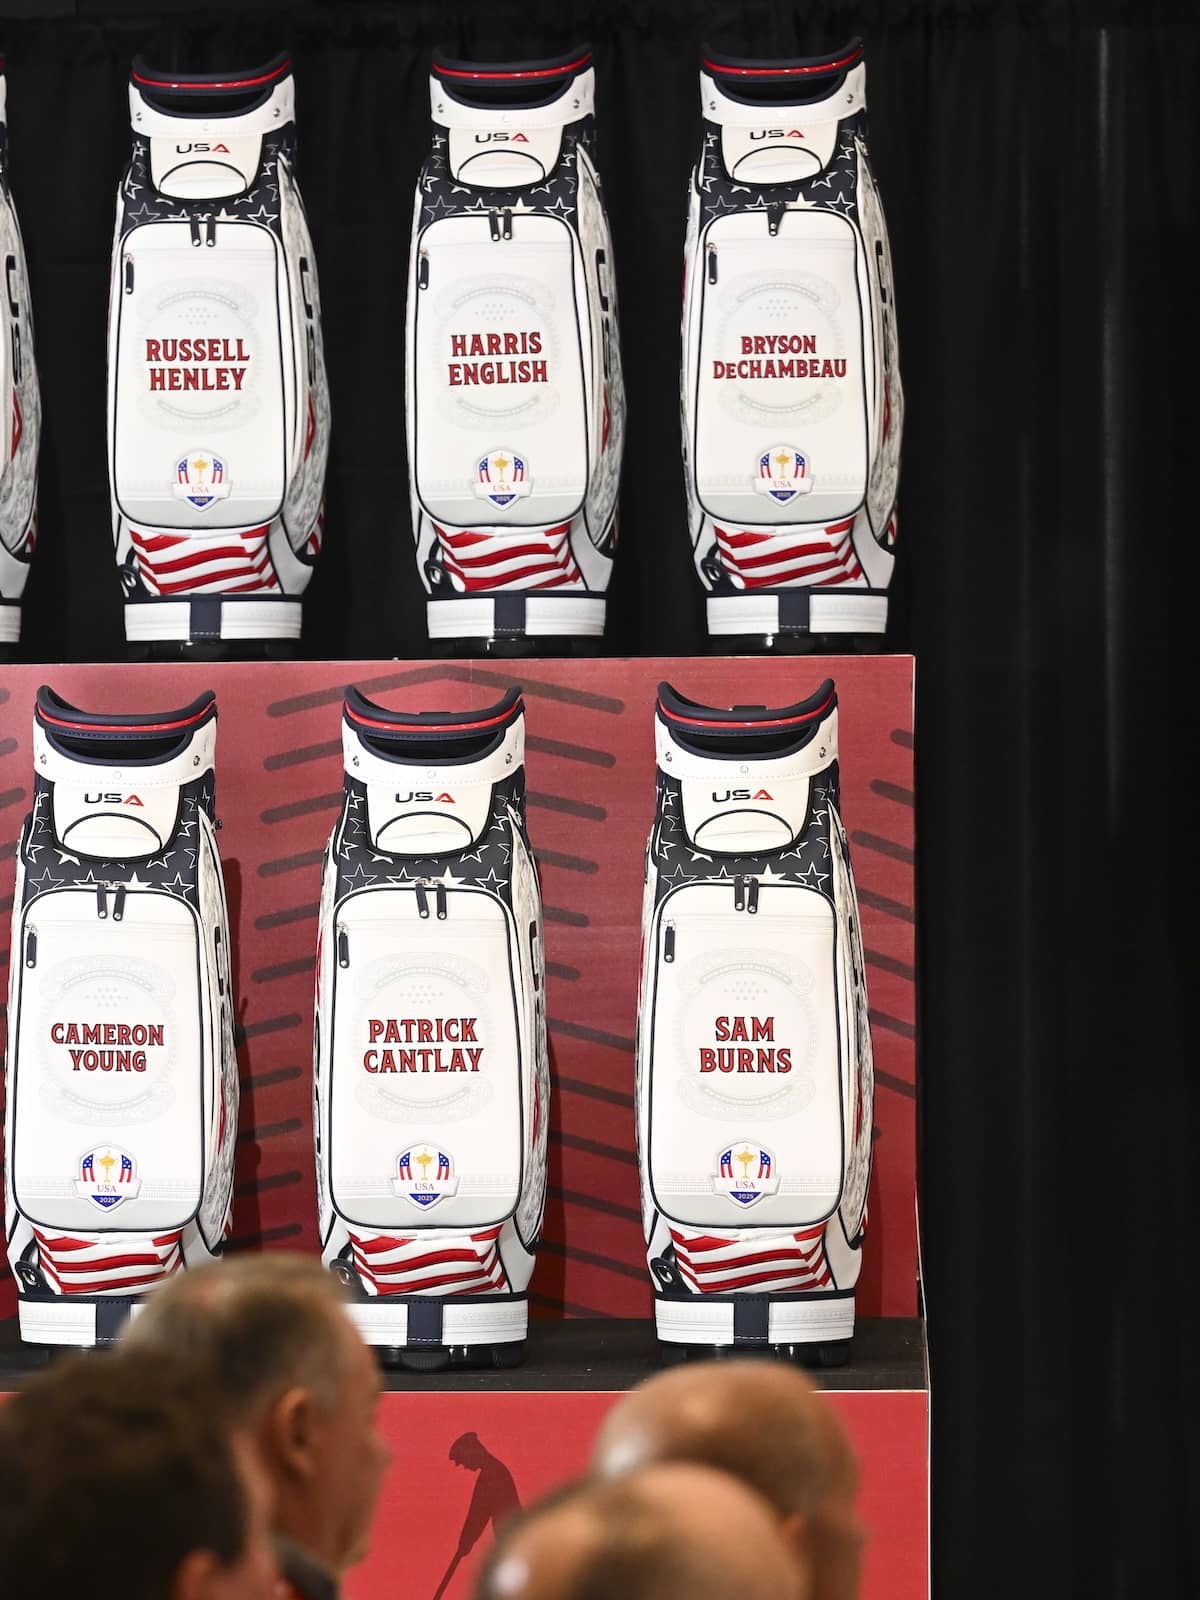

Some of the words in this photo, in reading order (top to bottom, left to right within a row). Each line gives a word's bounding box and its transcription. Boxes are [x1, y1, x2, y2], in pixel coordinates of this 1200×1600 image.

[476, 133, 528, 143] USA
[750, 130, 803, 140] USA
[177, 144, 229, 153] USA
[146, 339, 249, 361] RUSSELL
[452, 332, 542, 357] HARRIS
[742, 335, 816, 354] BRYSON
[150, 368, 246, 390] HENLEY
[449, 360, 547, 386] ENGLISH
[85, 793, 143, 806] USA
[396, 792, 454, 803] USA
[712, 790, 773, 802] USA
[51, 1023, 164, 1046] CAMERON
[369, 1018, 477, 1043] PATRICK
[716, 1016, 774, 1041] SAM
[69, 1050, 146, 1072] YOUNG
[364, 1048, 483, 1073] CANTLAY
[700, 1048, 791, 1073] BURNS
[97, 1185, 117, 1193] USA
[415, 1183, 434, 1191] USA
